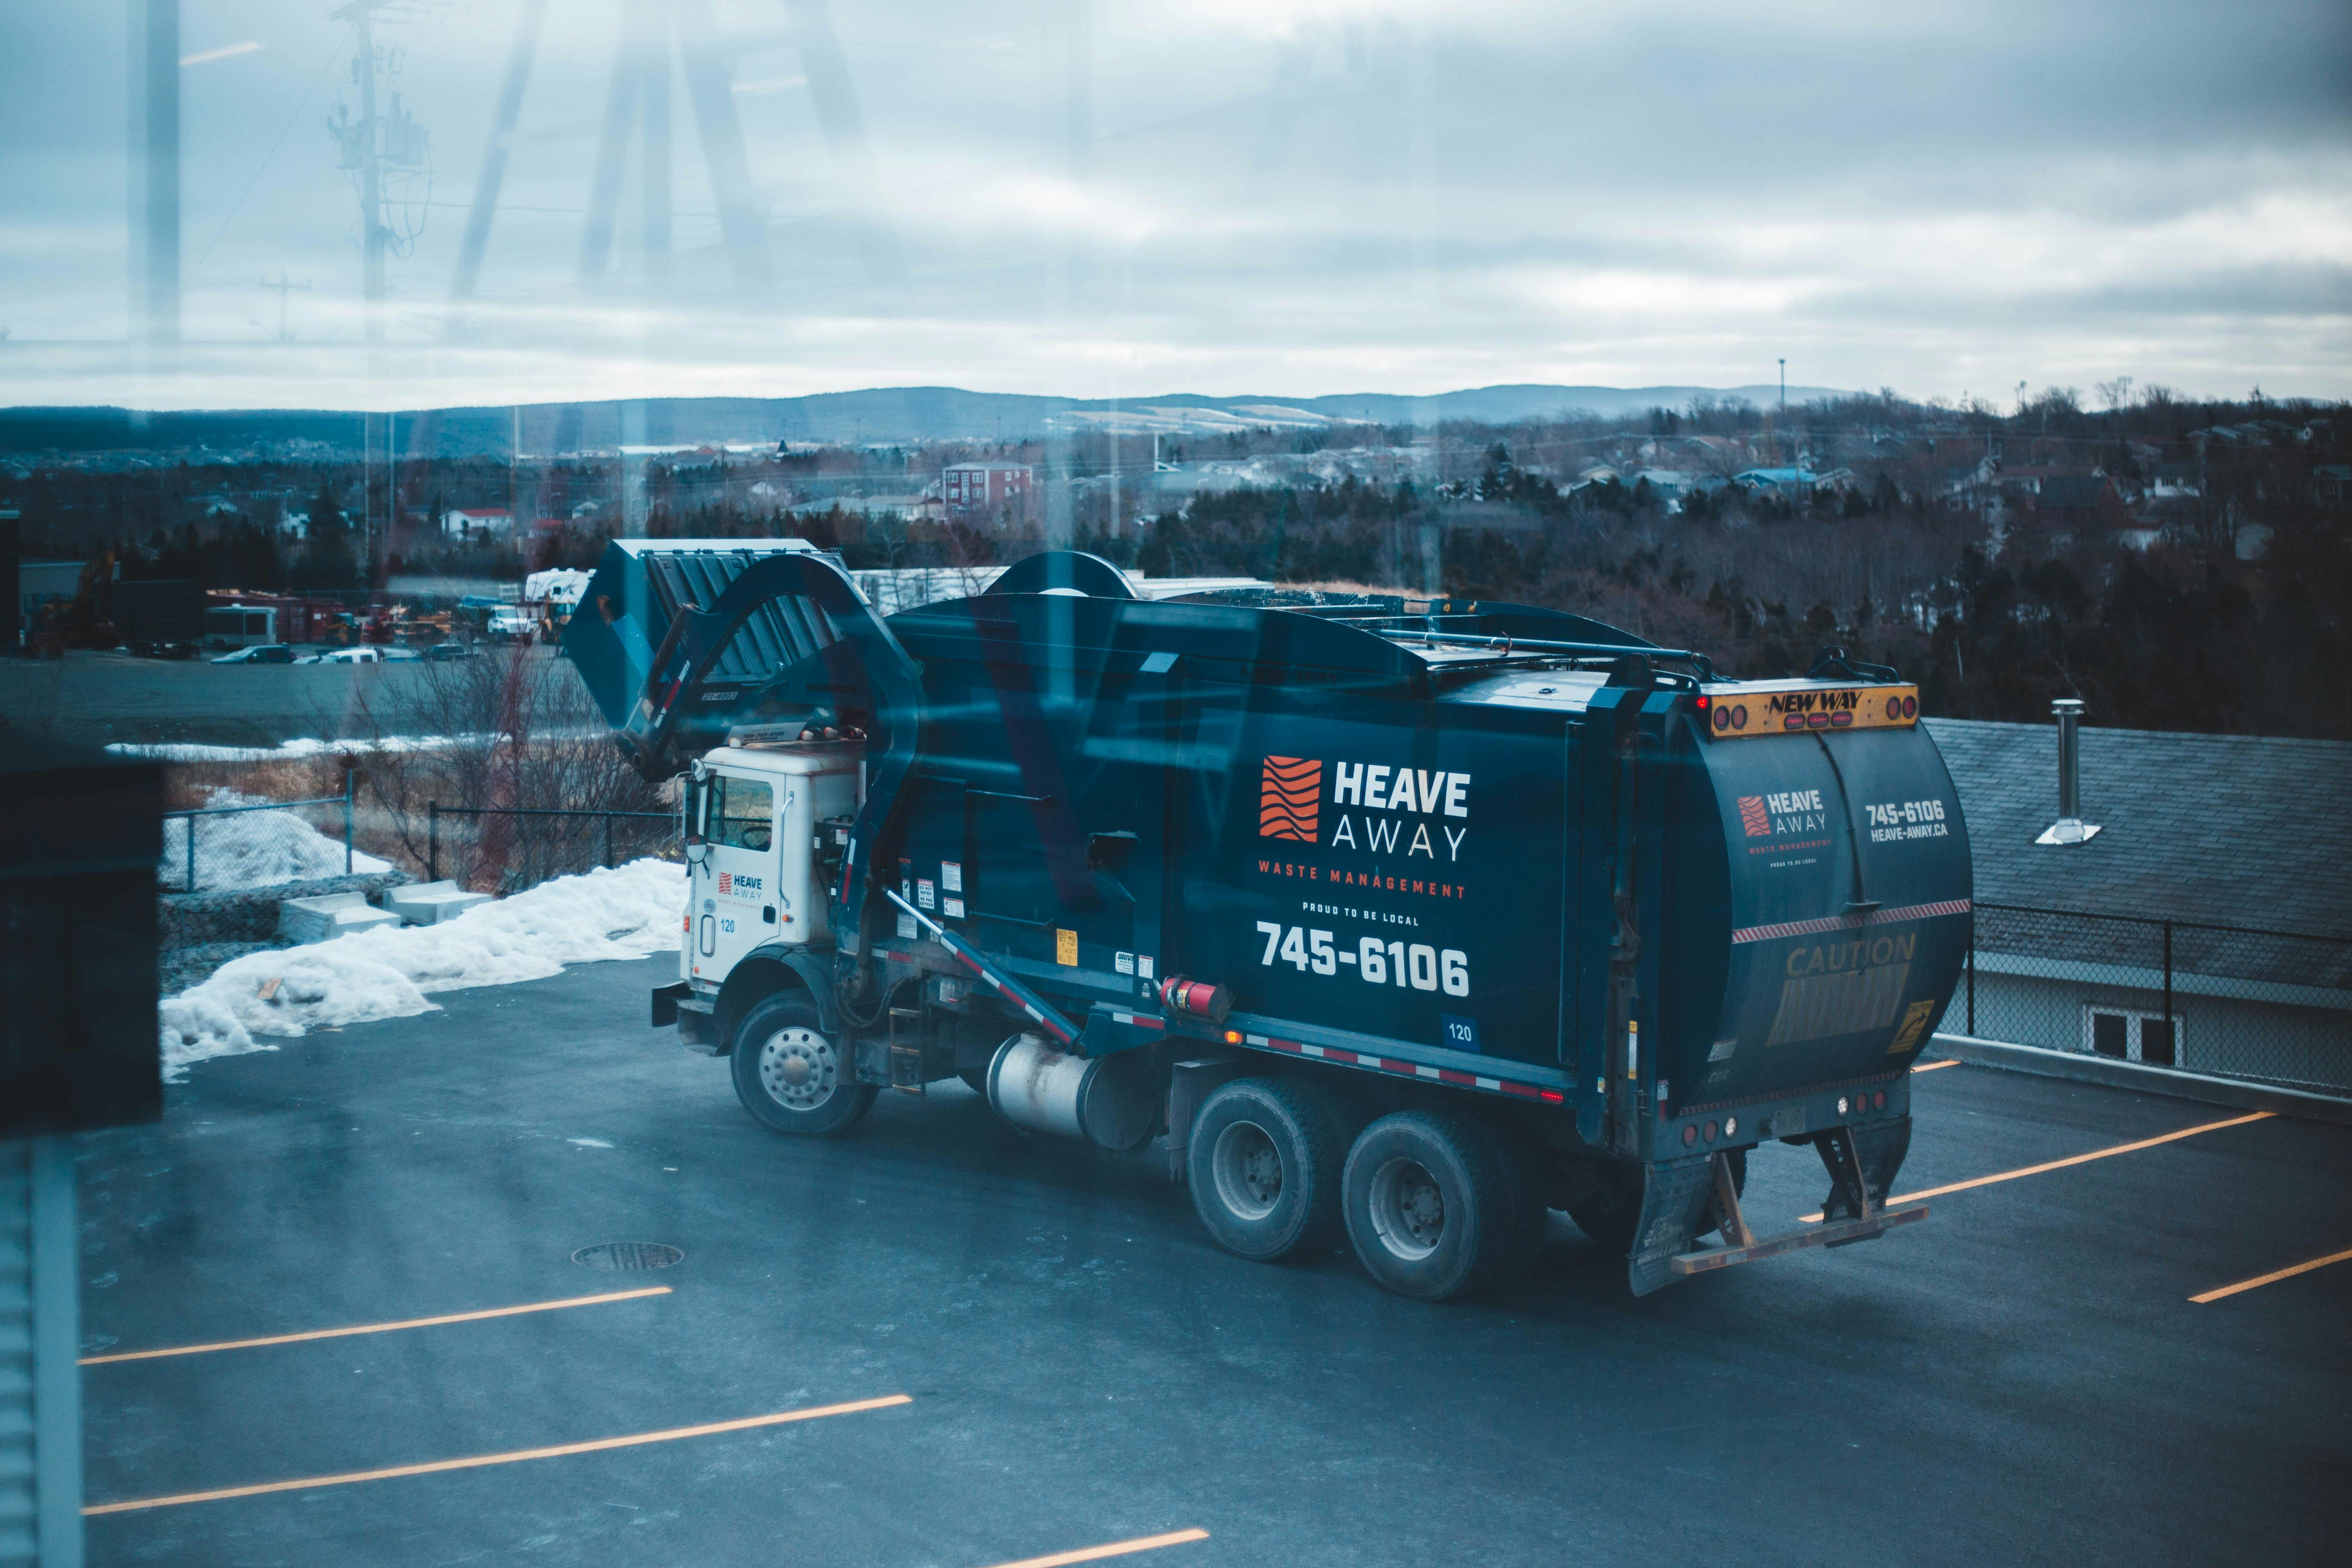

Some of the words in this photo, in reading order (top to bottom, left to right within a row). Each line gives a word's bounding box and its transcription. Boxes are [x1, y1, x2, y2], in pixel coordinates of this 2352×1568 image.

[1769, 693, 1818, 714] NEW
[1820, 691, 1863, 710] WAY
[1334, 761, 1471, 818] HEAVE
[1767, 790, 1823, 814] HEAVE
[1865, 799, 1945, 826] 745-6106
[1777, 813, 1825, 835] AWAY
[1871, 823, 1948, 842] HEAVE-AWAY.CA
[1332, 815, 1467, 861] AWAY
[1749, 845, 1775, 854] WASTE
[1779, 839, 1831, 851] MANAGEMENT
[734, 874, 762, 890] HEAVE
[1259, 860, 1317, 880] WASTE
[1330, 869, 1465, 899] MANAGEMENT
[734, 888, 762, 901] AWAY
[1303, 902, 1338, 916] PROUD
[1344, 908, 1357, 917] TO
[1364, 910, 1377, 921] BE
[1383, 913, 1419, 926] LOCAL
[721, 919, 735, 933] 120
[1257, 920, 1469, 997] 745-6106
[1786, 933, 1916, 977] CAUTION
[1449, 1023, 1472, 1042] 120
